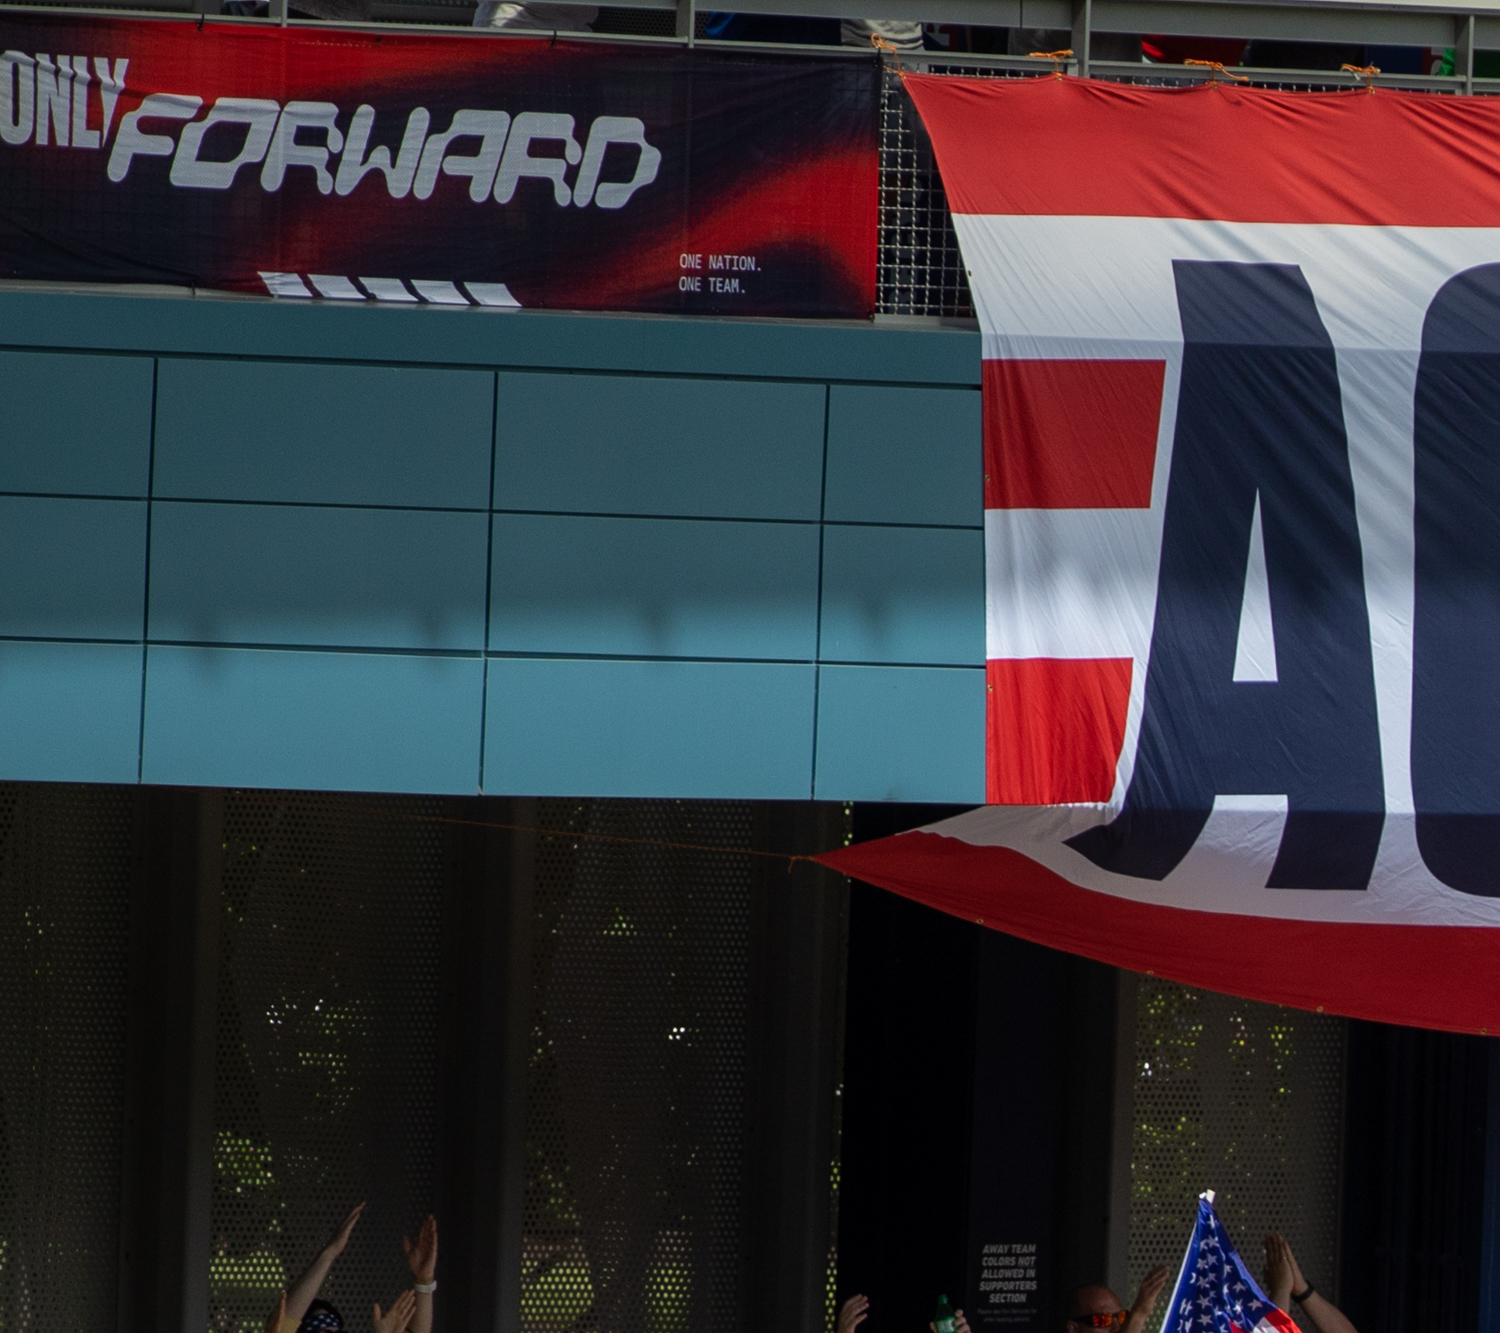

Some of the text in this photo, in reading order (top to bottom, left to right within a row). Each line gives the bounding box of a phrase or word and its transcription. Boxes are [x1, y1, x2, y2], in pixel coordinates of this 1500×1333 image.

[0, 49, 129, 149] ONLY
[106, 92, 662, 209] FORWARD
[679, 253, 761, 271] ONE NATION.
[678, 276, 745, 293] ONE TEAM.
[983, 1245, 1036, 1254] AWAY TEAM
[982, 1257, 1036, 1266] COLORS NOT
[982, 1269, 1035, 1279] ALLOWED IN
[980, 1281, 1037, 1291] SUPPORTERS
[989, 1293, 1027, 1303] SECTION
